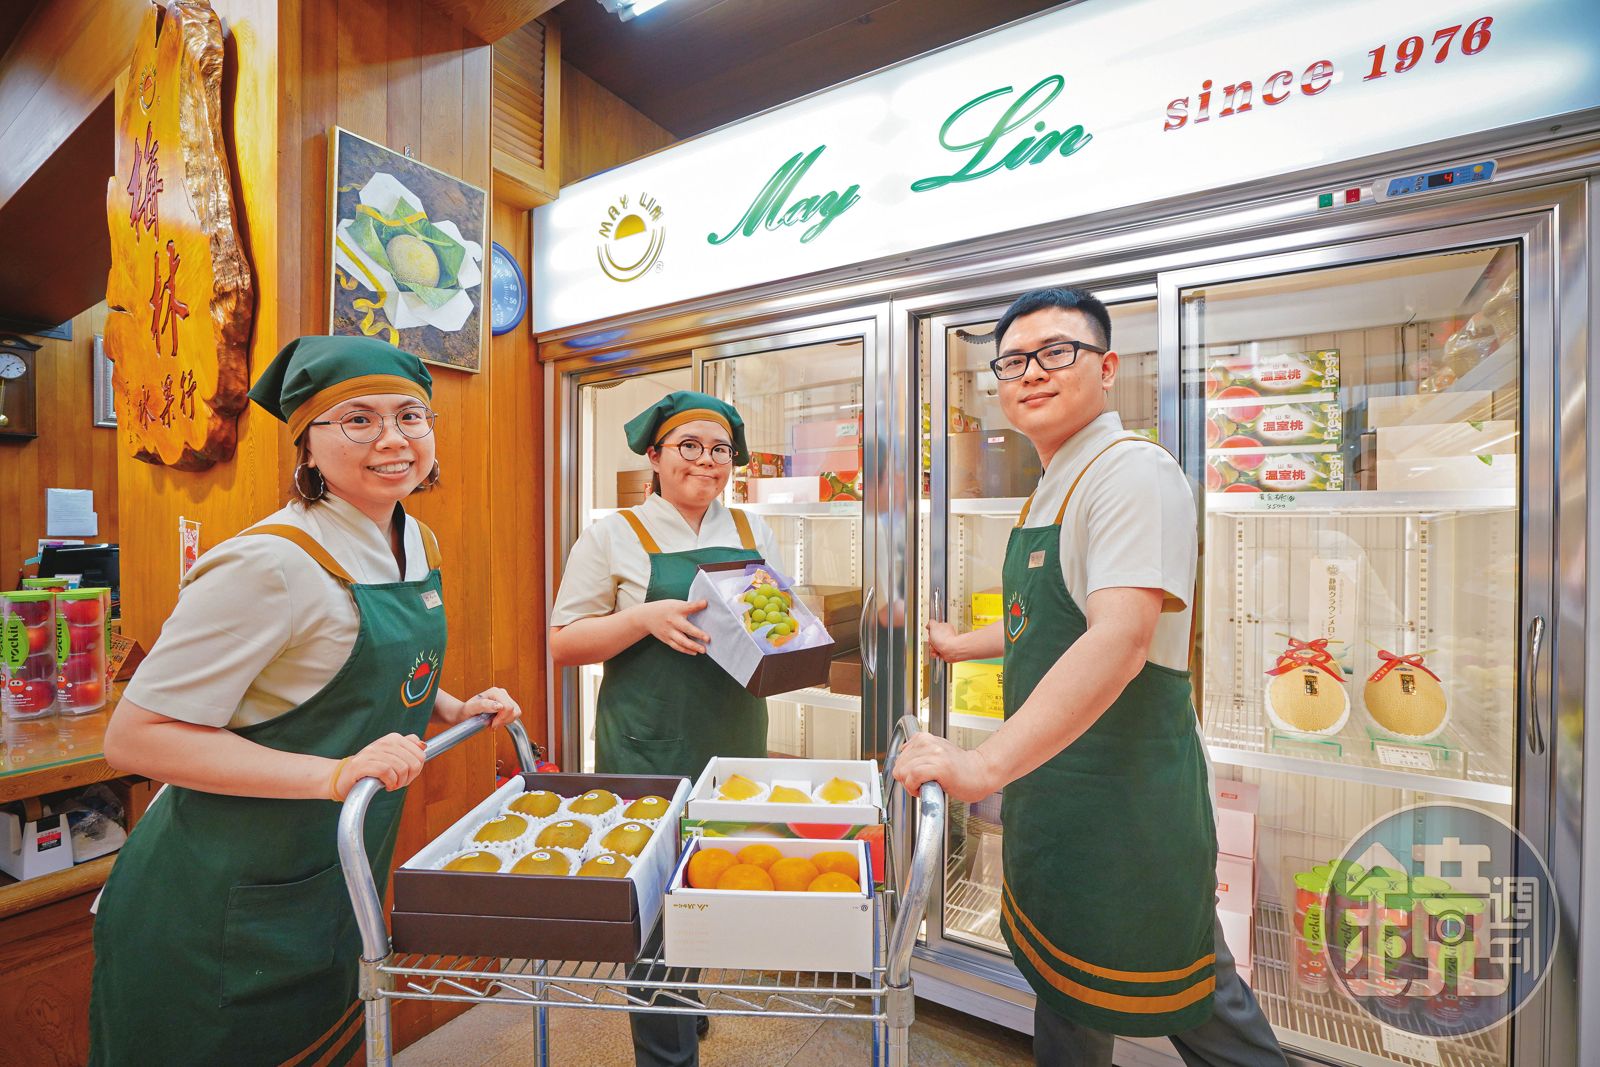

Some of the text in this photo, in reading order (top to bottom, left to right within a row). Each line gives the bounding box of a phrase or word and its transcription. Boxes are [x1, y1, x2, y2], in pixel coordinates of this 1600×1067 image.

[1163, 16, 1494, 131] since 1976
[707, 74, 1093, 245] May Lin
[1444, 173, 1453, 183] 4
[599, 192, 664, 239] MAY LIN
[494, 256, 503, 264] 20
[1260, 369, 1301, 382] 温室桃
[1321, 351, 1336, 388] Fresh
[139, 369, 197, 430] 水果行
[1263, 420, 1304, 432] 温室桃
[1323, 403, 1338, 440] Fresh
[1265, 469, 1306, 481] 温室桃
[1326, 454, 1341, 491] Fresh
[1327, 577, 1337, 640] 静岡クラウンメロン
[8, 625, 20, 663] rockit
[408, 649, 439, 678] MAY LIN
[1308, 913, 1320, 946] rockit
